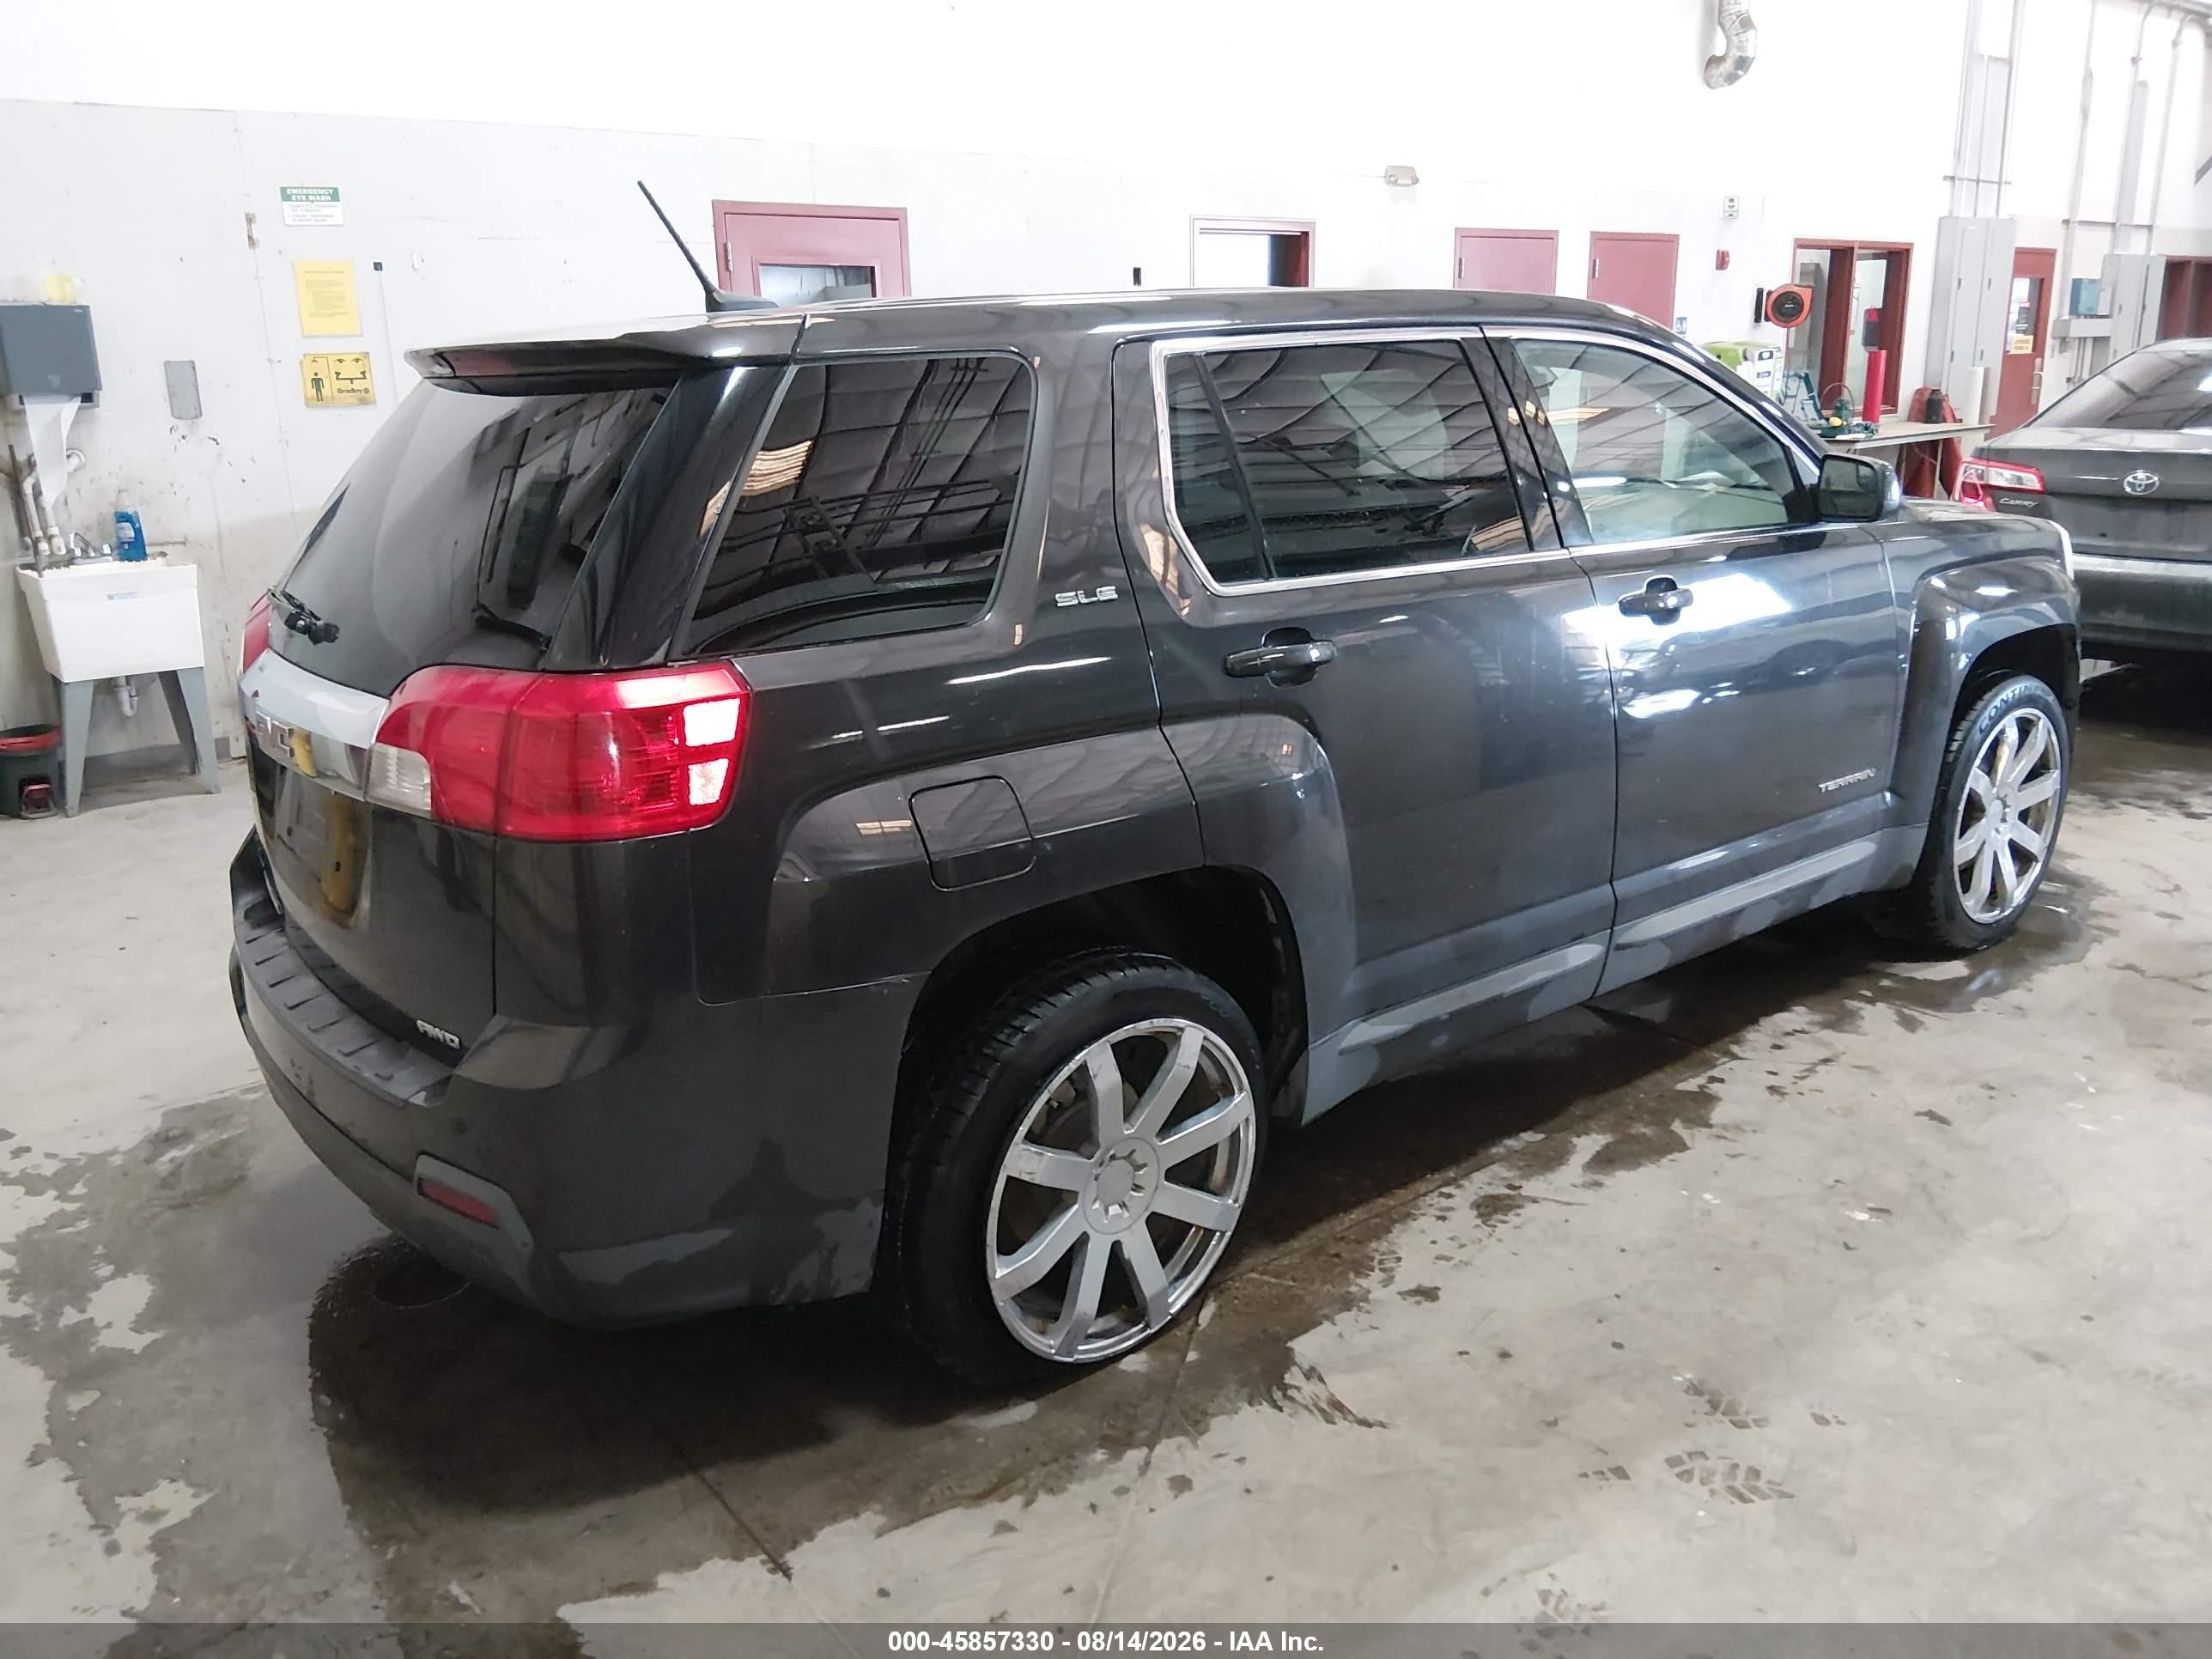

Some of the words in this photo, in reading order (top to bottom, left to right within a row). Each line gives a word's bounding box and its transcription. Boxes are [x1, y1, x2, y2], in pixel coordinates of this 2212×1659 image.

[1054, 586, 1118, 606] SLE
[1818, 768, 1875, 793] TERRAIN
[416, 1018, 460, 1049] AWD
